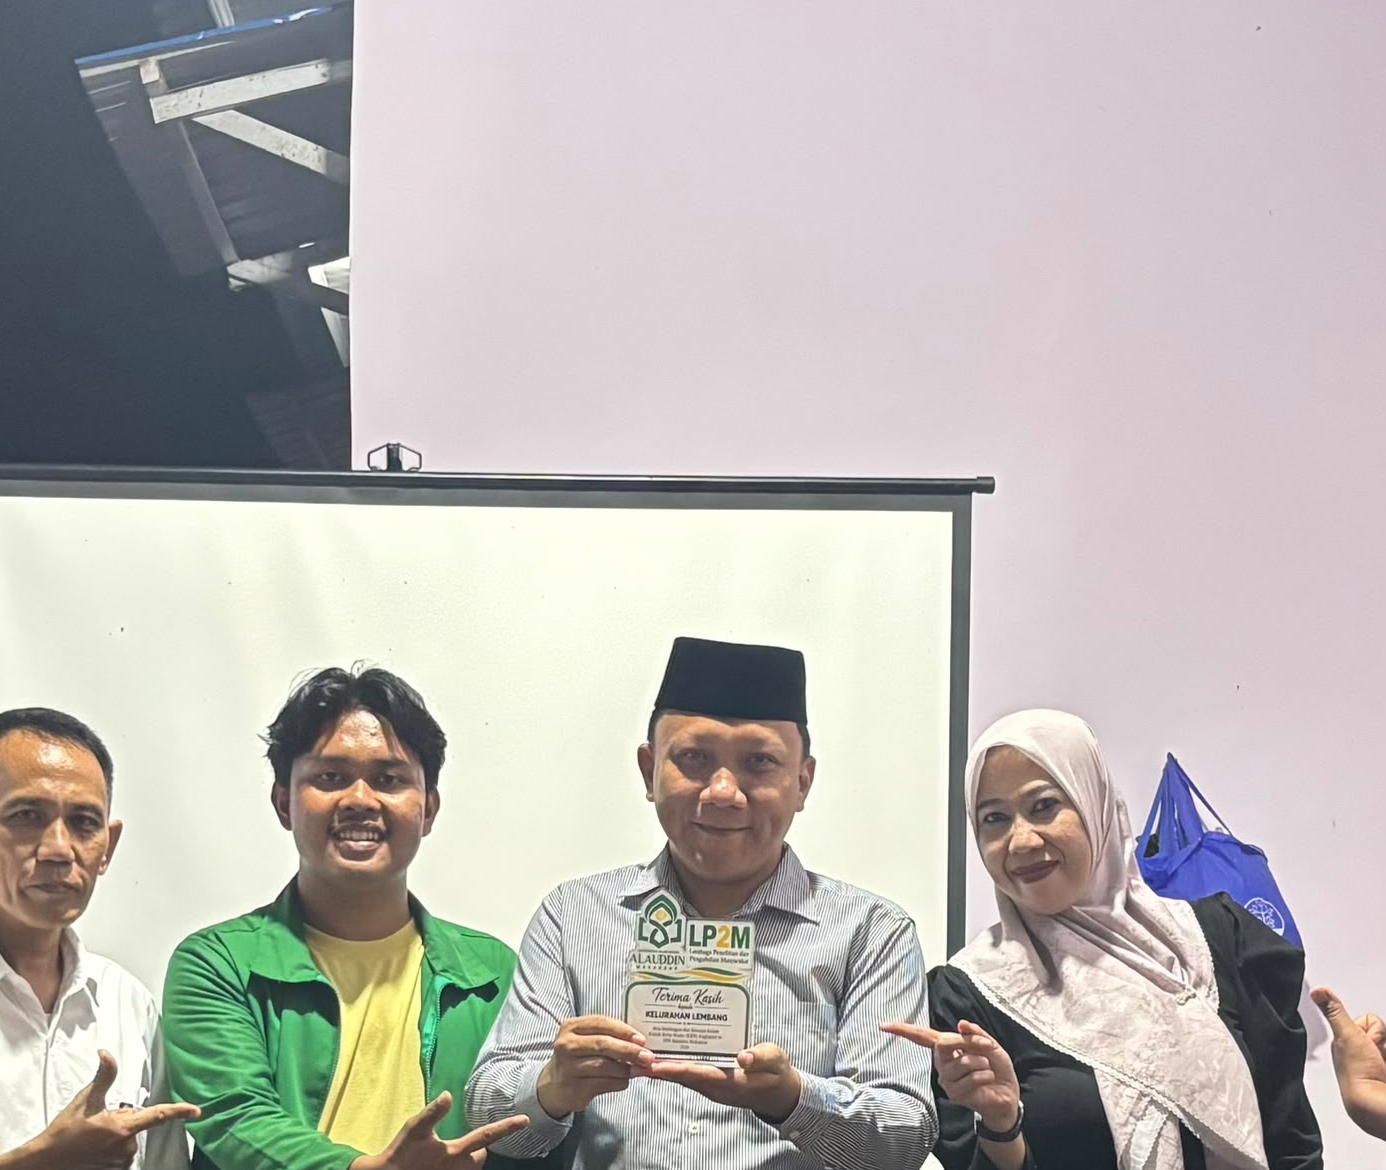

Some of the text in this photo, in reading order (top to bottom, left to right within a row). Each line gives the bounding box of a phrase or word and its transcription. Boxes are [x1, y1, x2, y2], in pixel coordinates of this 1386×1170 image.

[689, 924, 751, 949] LP2M
[630, 953, 685, 966] ALAUDDIN
[652, 987, 724, 1005] Terima Kasih
[645, 1010, 728, 1021] KELURAHAN LEMBANG
